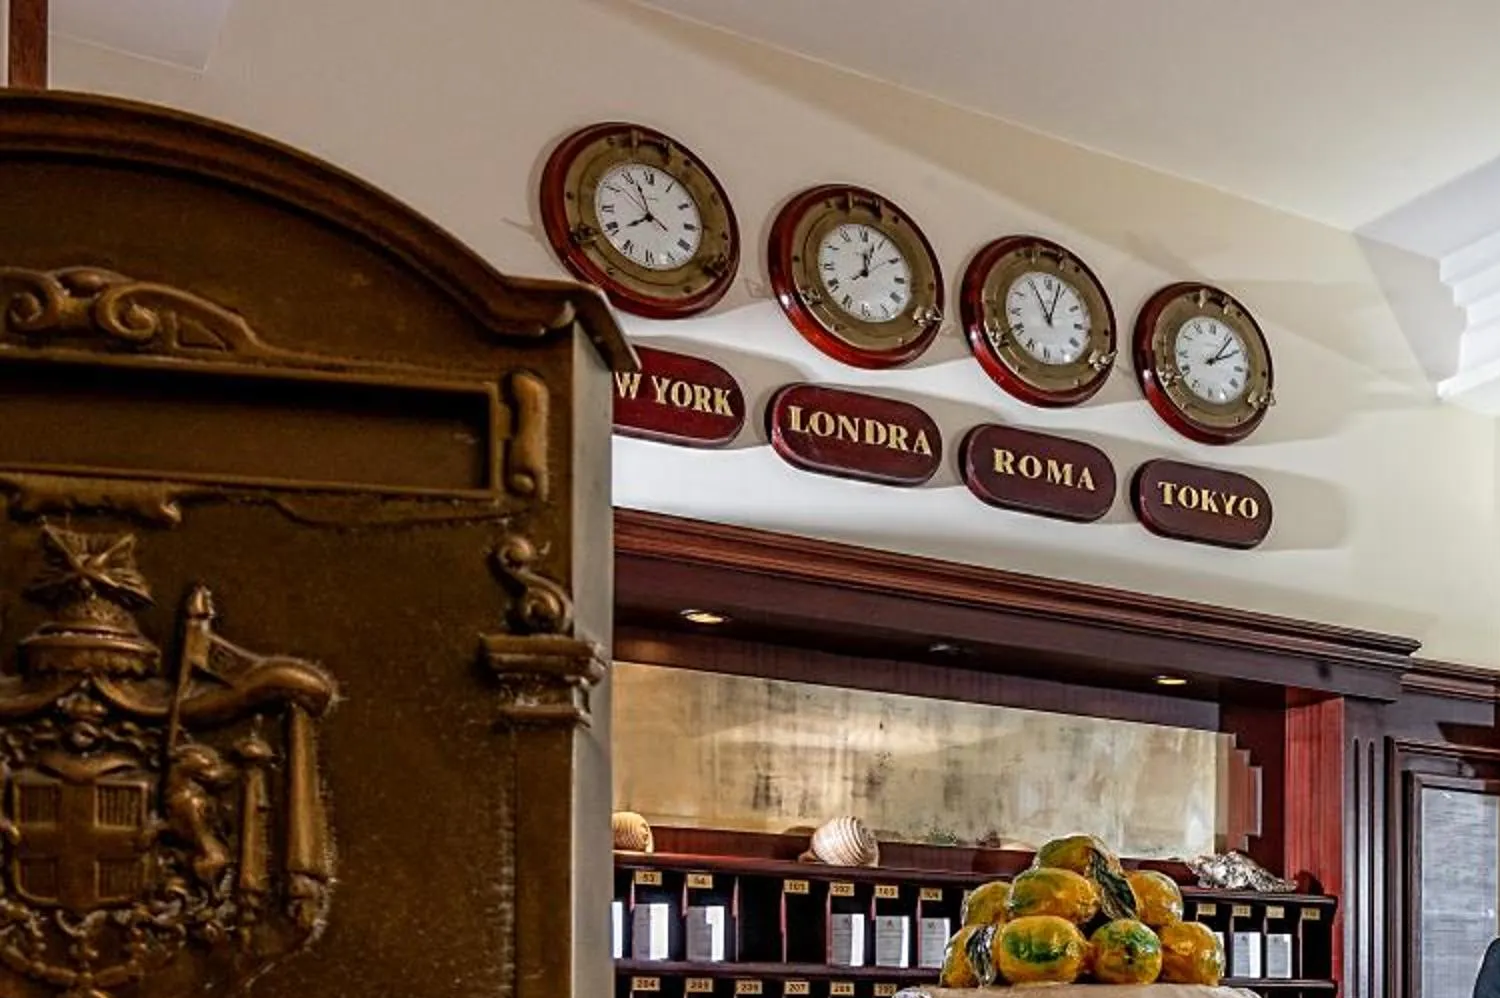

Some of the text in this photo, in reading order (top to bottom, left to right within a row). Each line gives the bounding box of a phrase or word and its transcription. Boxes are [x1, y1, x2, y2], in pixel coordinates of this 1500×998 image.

[652, 375, 734, 417] YORK
[788, 405, 933, 456] LONDRA
[992, 448, 1096, 491] ROMA
[1157, 481, 1259, 519] TOKYO
